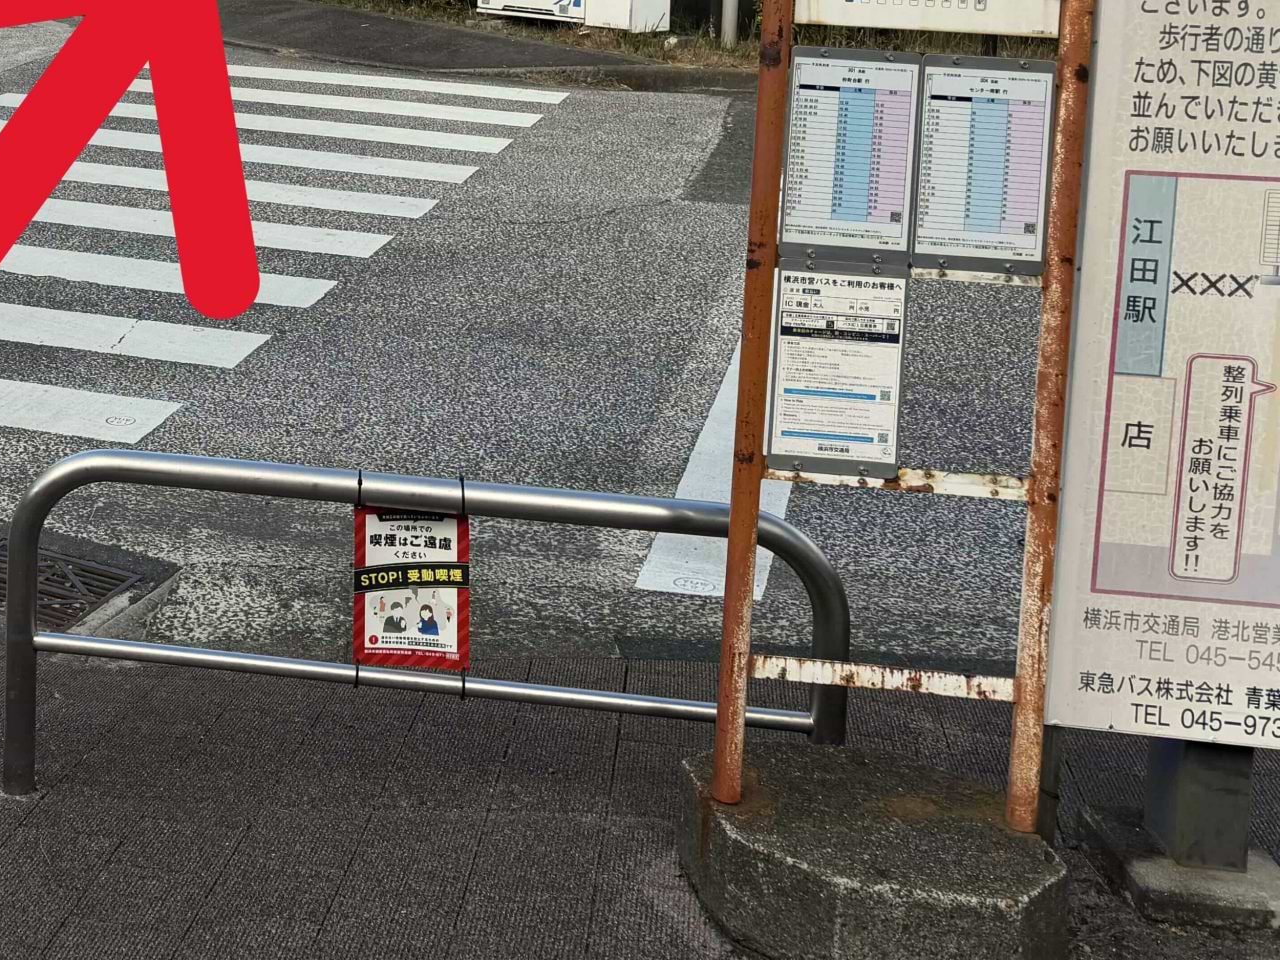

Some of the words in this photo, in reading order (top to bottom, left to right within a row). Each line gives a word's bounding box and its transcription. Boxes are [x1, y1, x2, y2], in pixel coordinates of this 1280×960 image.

[1159, 22, 1280, 53] 歩行者の通り
[1134, 56, 1280, 90] ため、下図の黄
[1130, 91, 1280, 123] 並んでいただ
[784, 275, 902, 291] 横浜市営バスをご利用のお客様へ
[1124, 218, 1163, 324] 江田駅
[1121, 421, 1154, 450] 店
[1209, 365, 1246, 540] 整列乗車にご協力を
[1183, 437, 1214, 573] お願いします!!
[369, 533, 452, 551] 喫煙はご遠慮
[389, 524, 432, 533] この場所での
[394, 551, 427, 559] ください
[360, 571, 402, 586] STOP!
[407, 569, 463, 583] 受動喫煙
[1083, 606, 1200, 639] 横浜市交通局
[1135, 639, 1175, 662] TEL
[1078, 670, 1233, 706] 東急バス株式会社
[1245, 686, 1280, 711] 青葉
[1131, 703, 1170, 727] TEL
